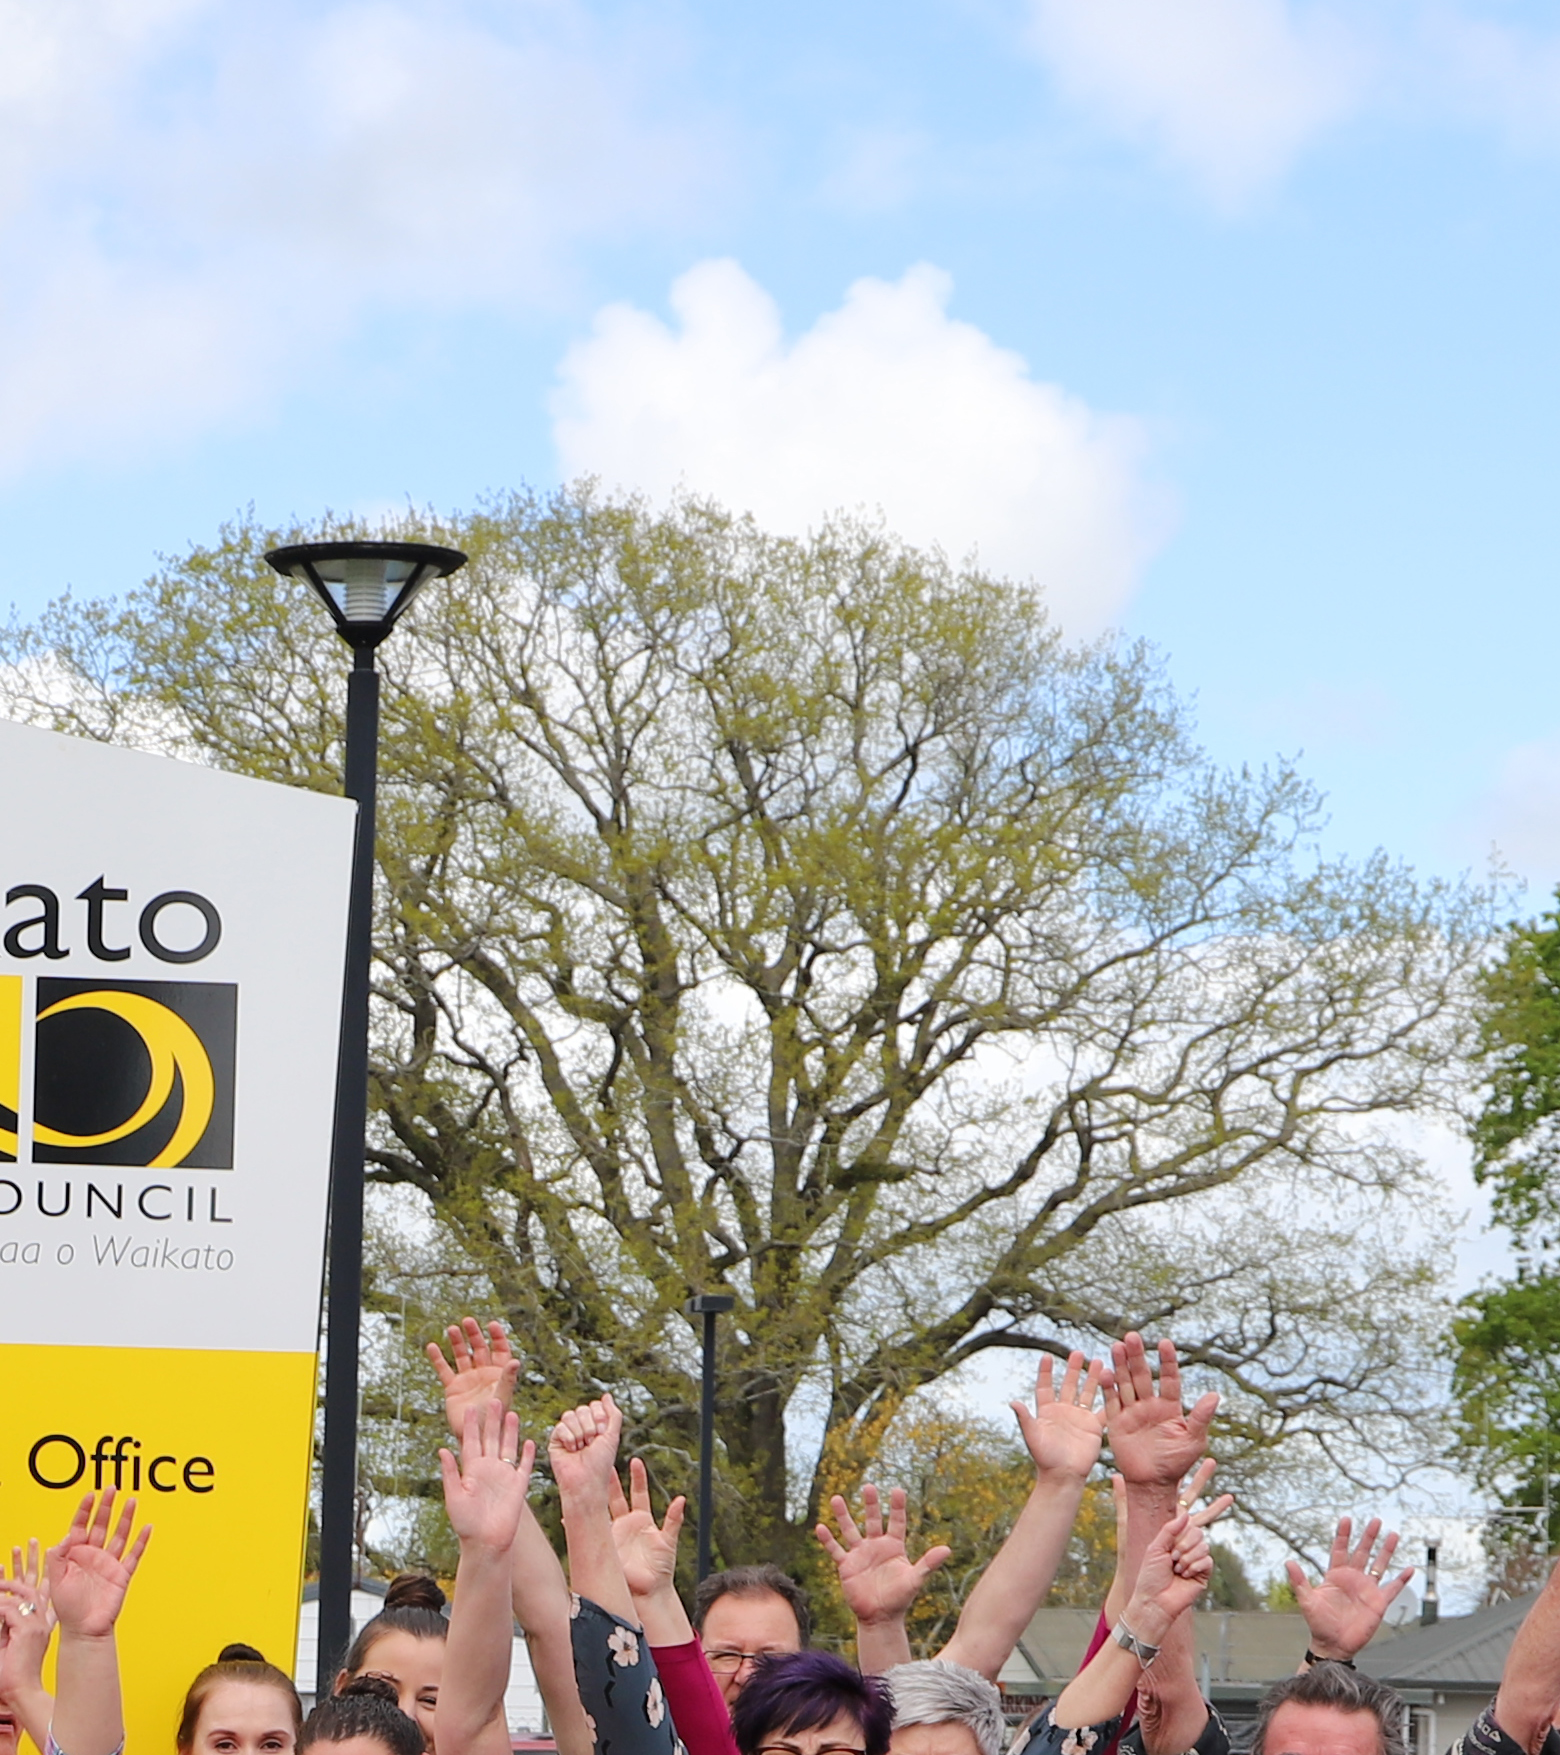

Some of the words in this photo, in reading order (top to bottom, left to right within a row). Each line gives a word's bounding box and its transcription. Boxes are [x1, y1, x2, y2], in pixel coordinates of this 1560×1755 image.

[56, 1243, 75, 1265] o
[92, 1234, 234, 1271] Waikato
[28, 1433, 216, 1492] Office
